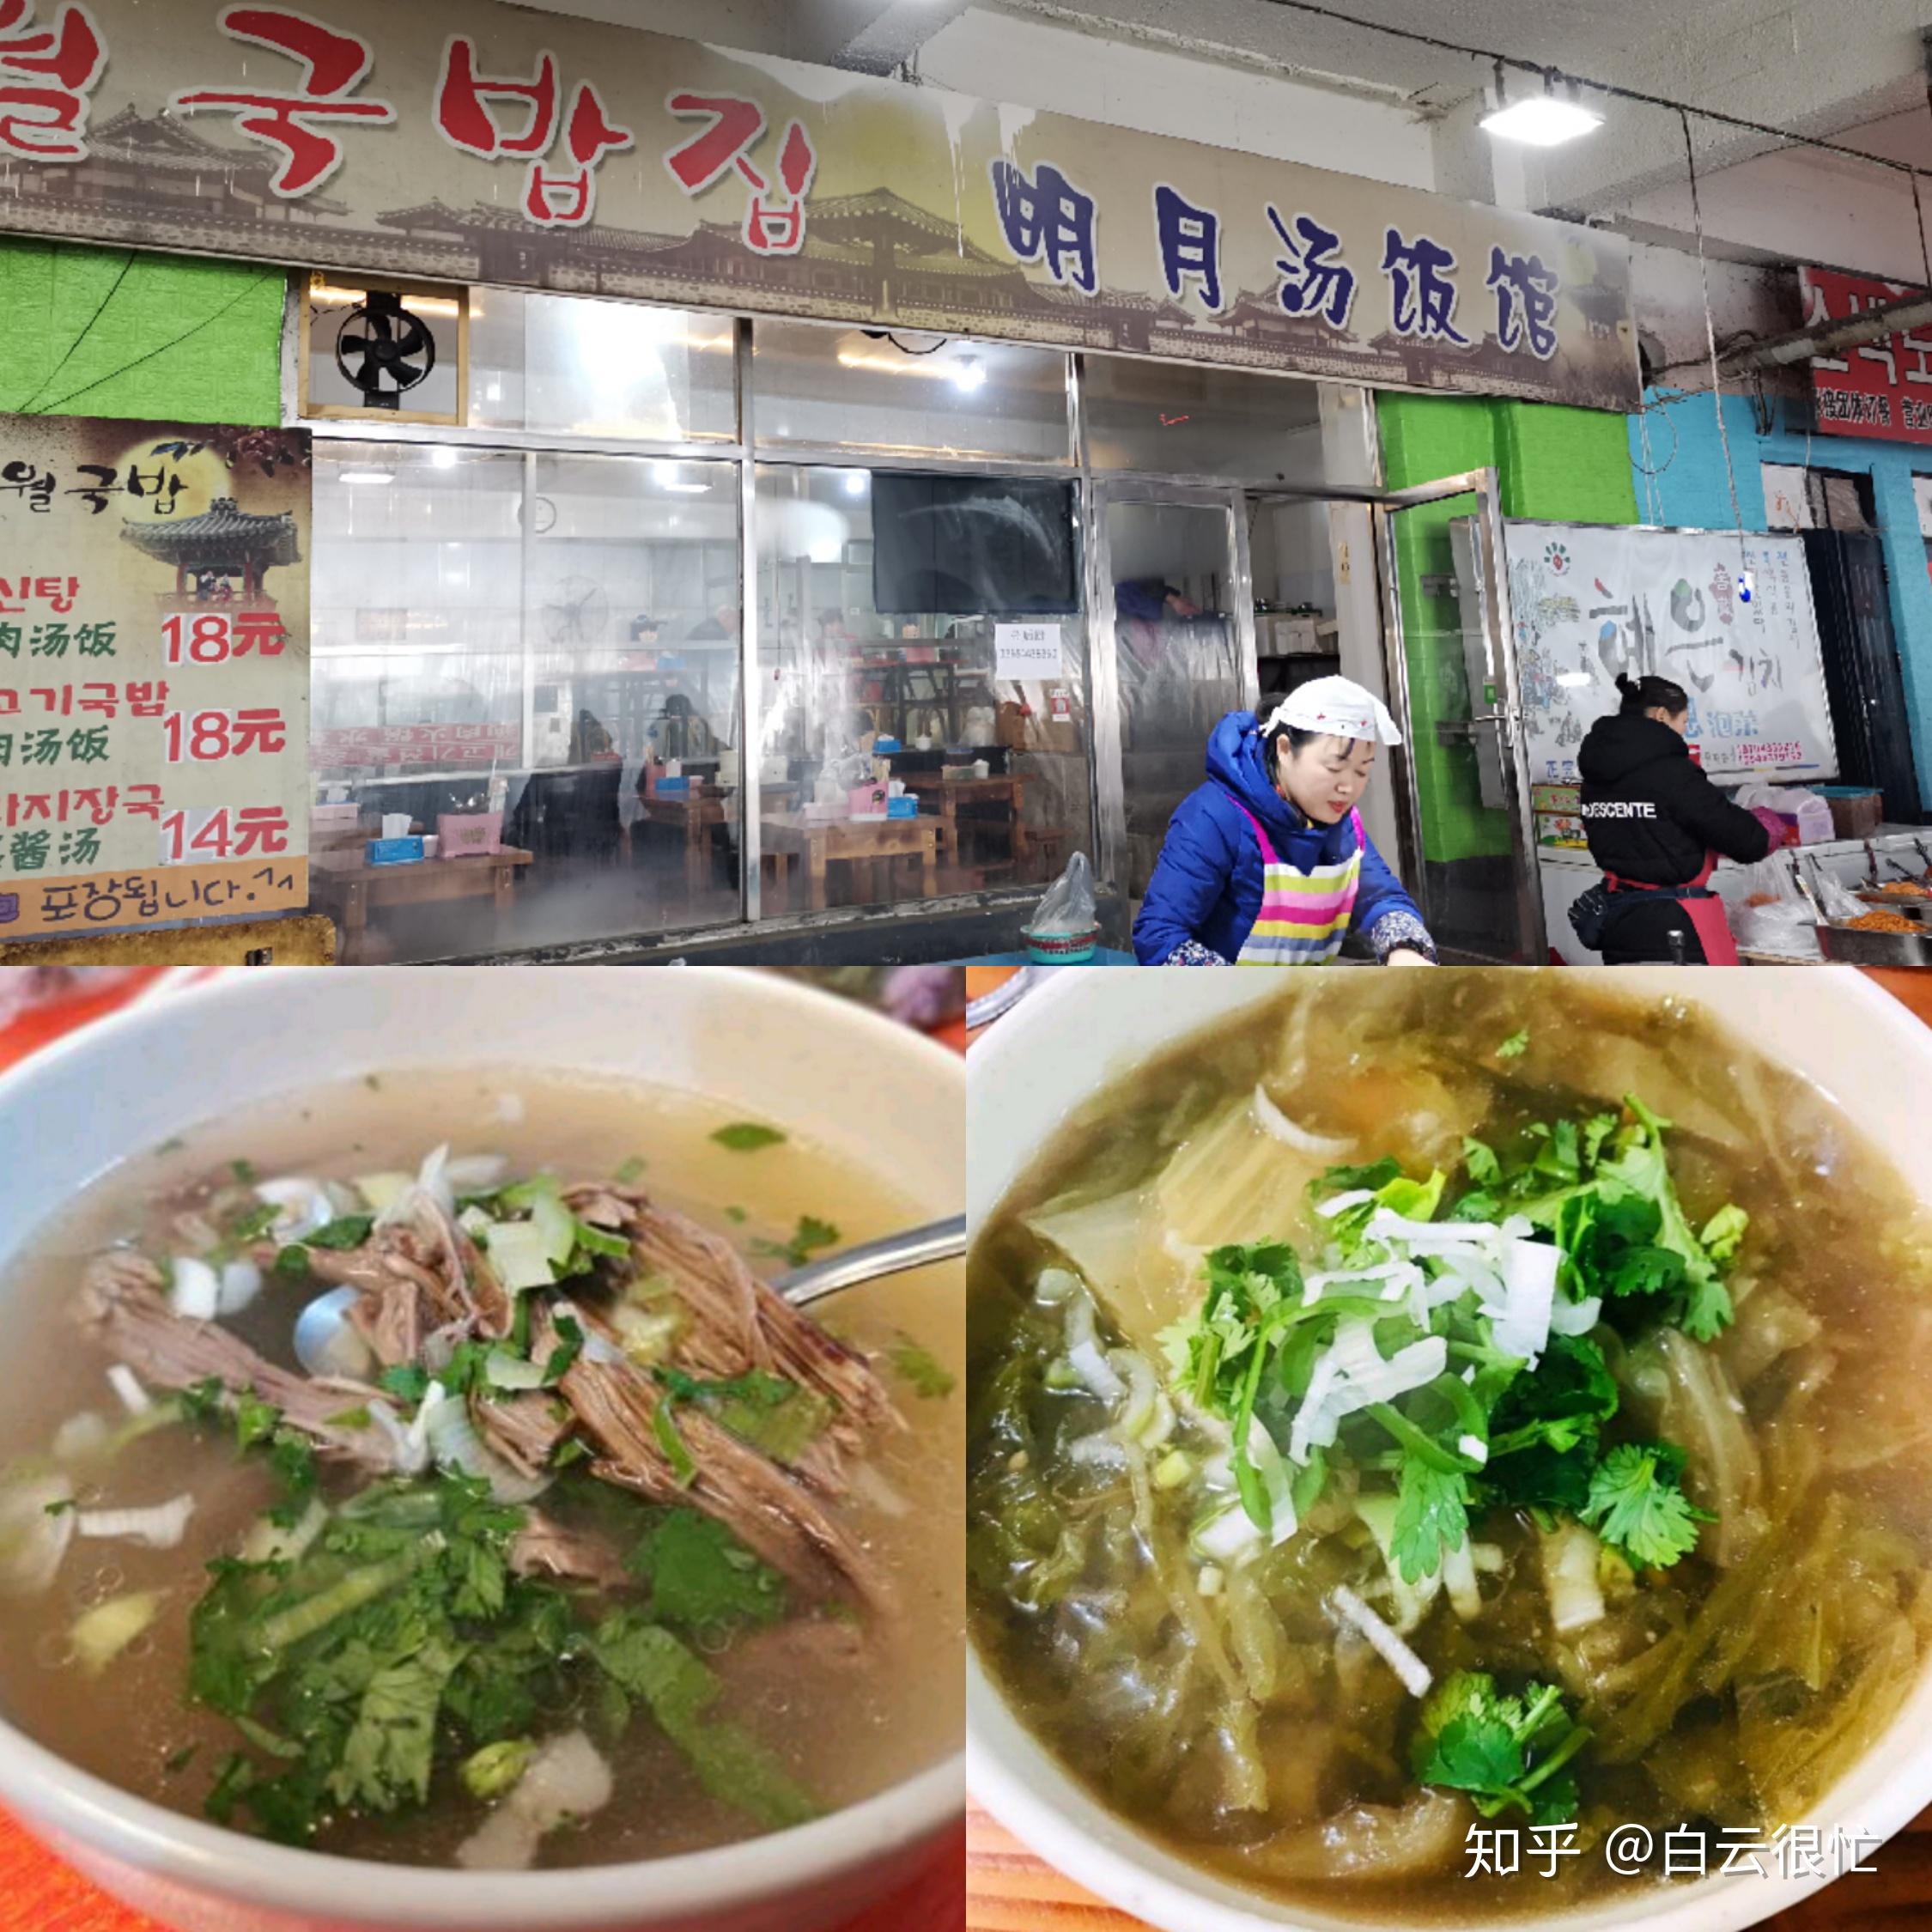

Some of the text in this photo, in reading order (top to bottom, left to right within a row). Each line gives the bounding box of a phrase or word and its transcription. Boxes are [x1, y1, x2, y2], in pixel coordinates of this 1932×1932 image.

[991, 159, 1557, 357] 明月汤饭馆
[0, 460, 189, 515] 월국밥
[161, 613, 287, 663] 18元
[163, 708, 286, 762] 18元
[0, 827, 101, 872] 酱汤
[161, 805, 289, 860] 14元
